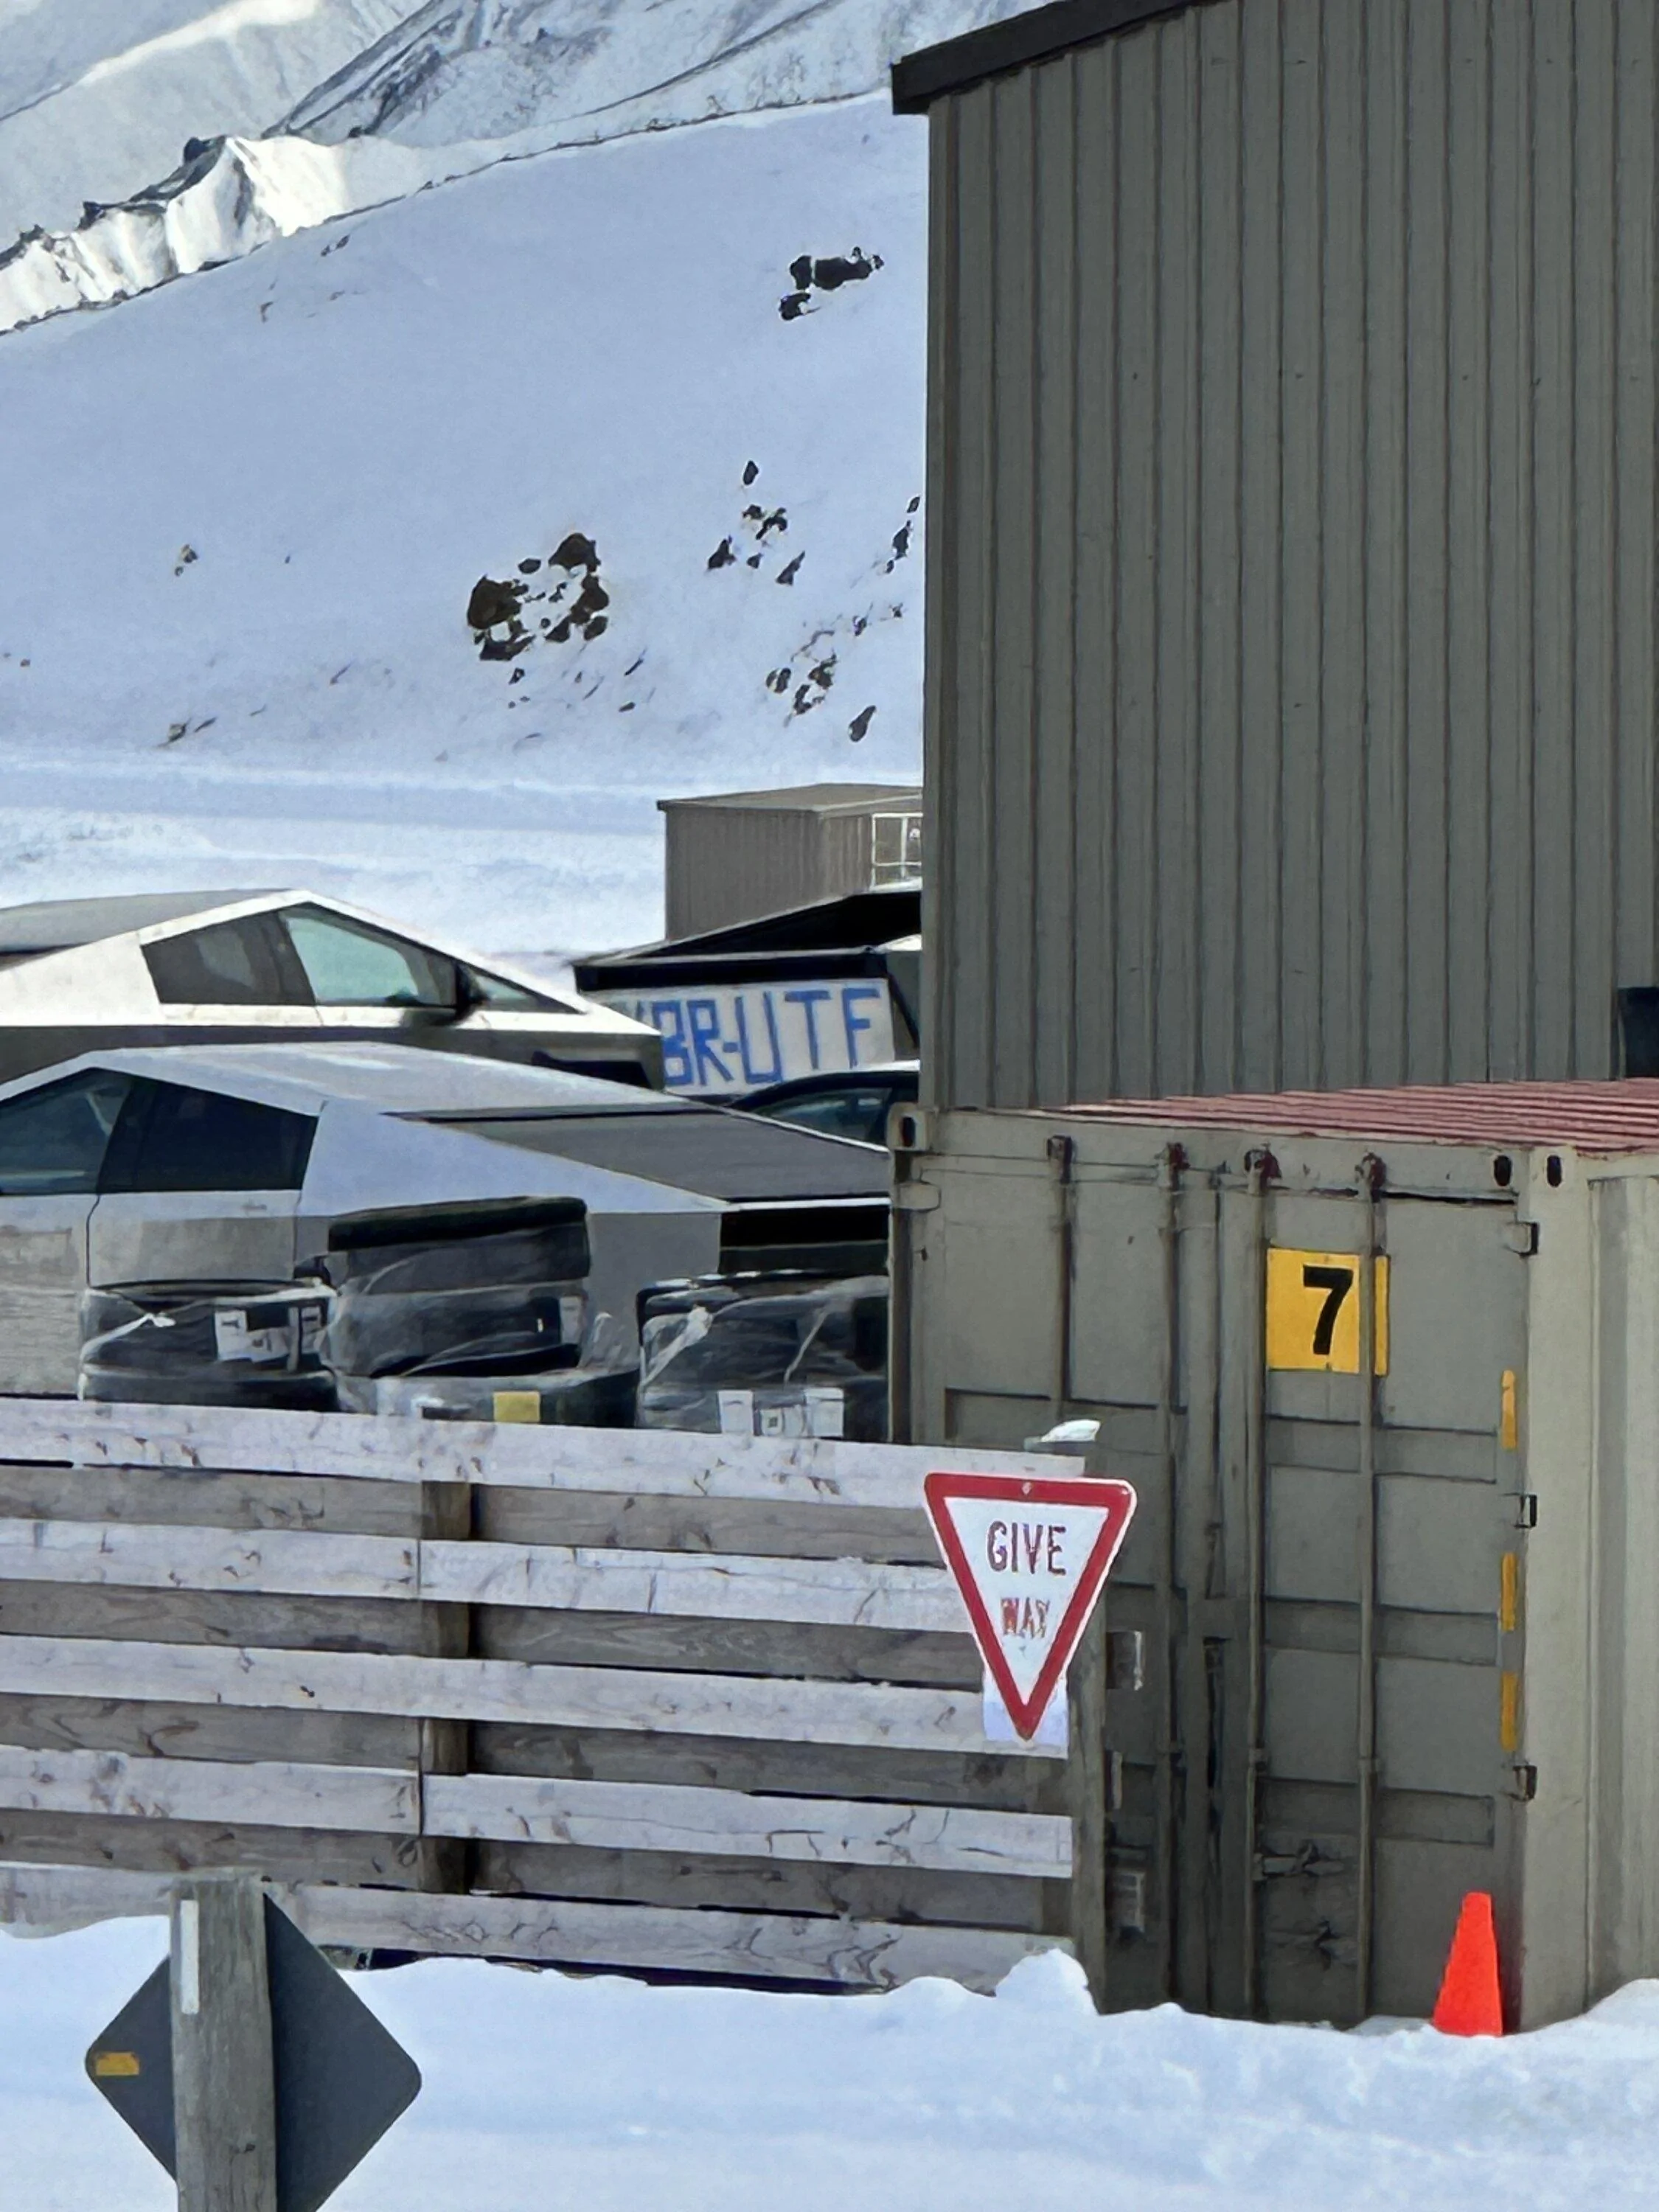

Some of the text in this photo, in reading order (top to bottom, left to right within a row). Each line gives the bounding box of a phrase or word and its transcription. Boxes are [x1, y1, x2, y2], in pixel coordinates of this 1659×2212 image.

[1302, 1265, 1354, 1355] 7
[986, 1520, 1068, 1576] GIVE
[1001, 1596, 1051, 1639] WAY
